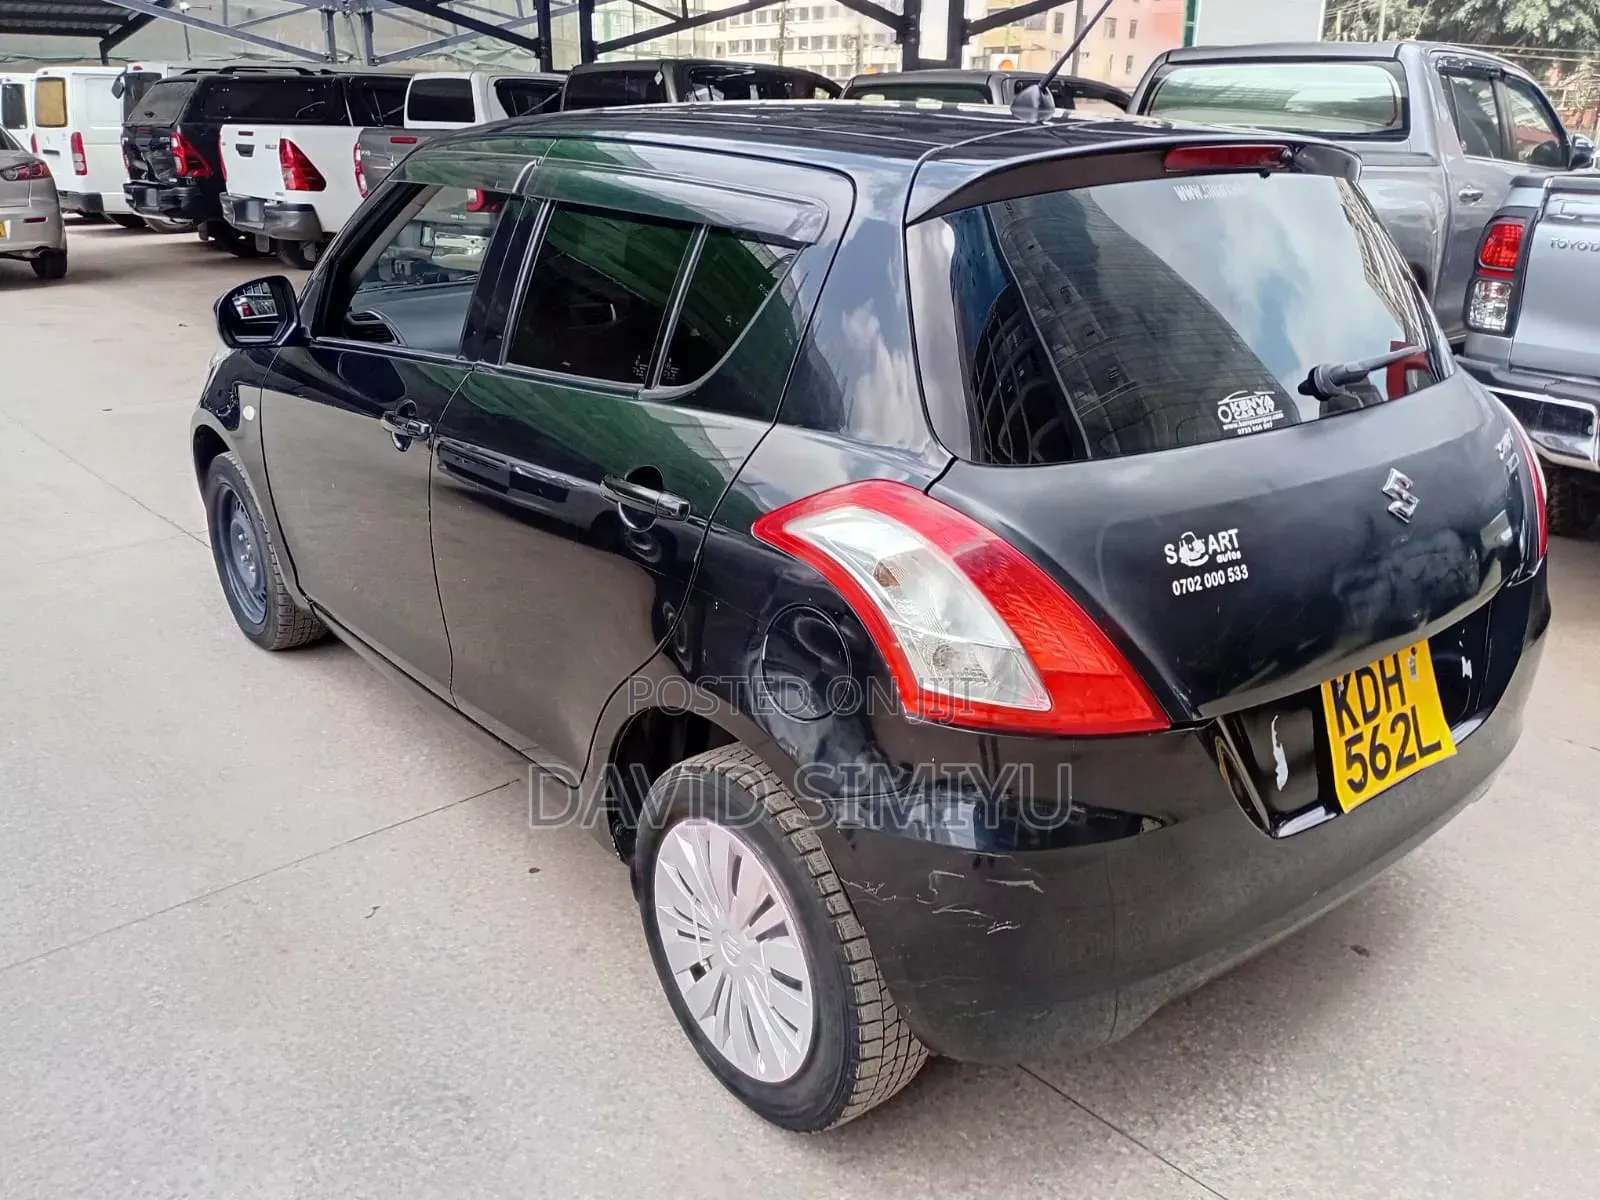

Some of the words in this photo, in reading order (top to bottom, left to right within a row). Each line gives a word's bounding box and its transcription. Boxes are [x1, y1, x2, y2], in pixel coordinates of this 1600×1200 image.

[1550, 238, 1600, 252] TOYOT
[1216, 550, 1241, 563] autos
[1172, 575, 1202, 596] 0702
[1204, 569, 1225, 588] 000
[1227, 564, 1249, 583] 533
[1330, 652, 1406, 737] KDH
[1344, 704, 1442, 793] 562L
